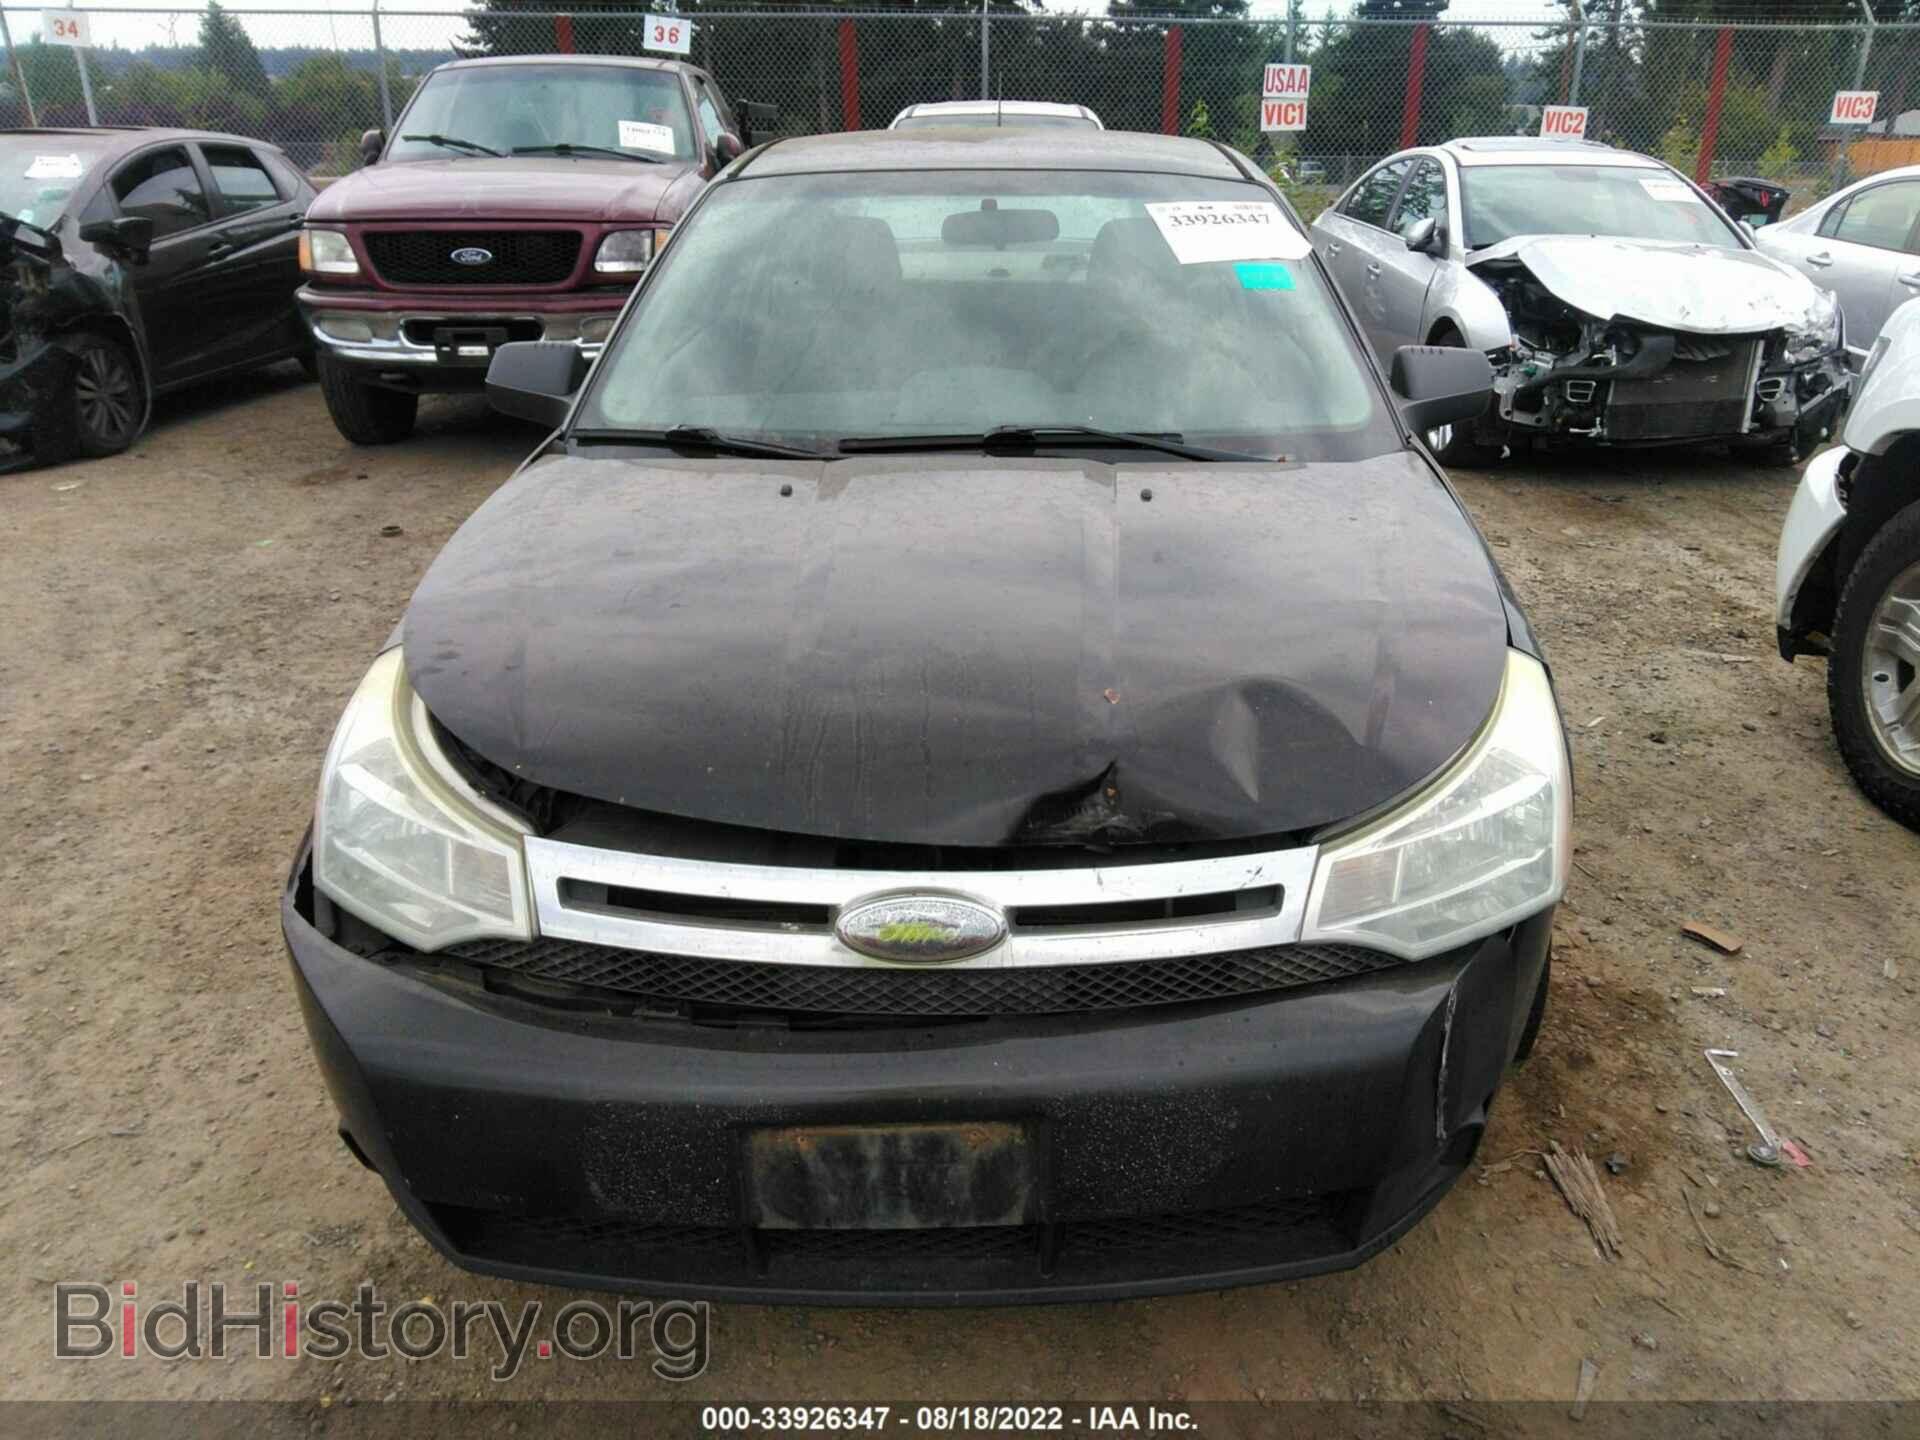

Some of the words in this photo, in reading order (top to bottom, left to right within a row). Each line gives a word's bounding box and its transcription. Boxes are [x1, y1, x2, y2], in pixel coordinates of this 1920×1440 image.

[53, 19, 79, 38] 34
[654, 25, 680, 44] 36
[1265, 67, 1308, 93] USAA
[1264, 103, 1304, 126] VIC1
[1835, 96, 1874, 118] VIC3
[1546, 111, 1585, 134] VIC2
[1169, 212, 1271, 227] 33926347
